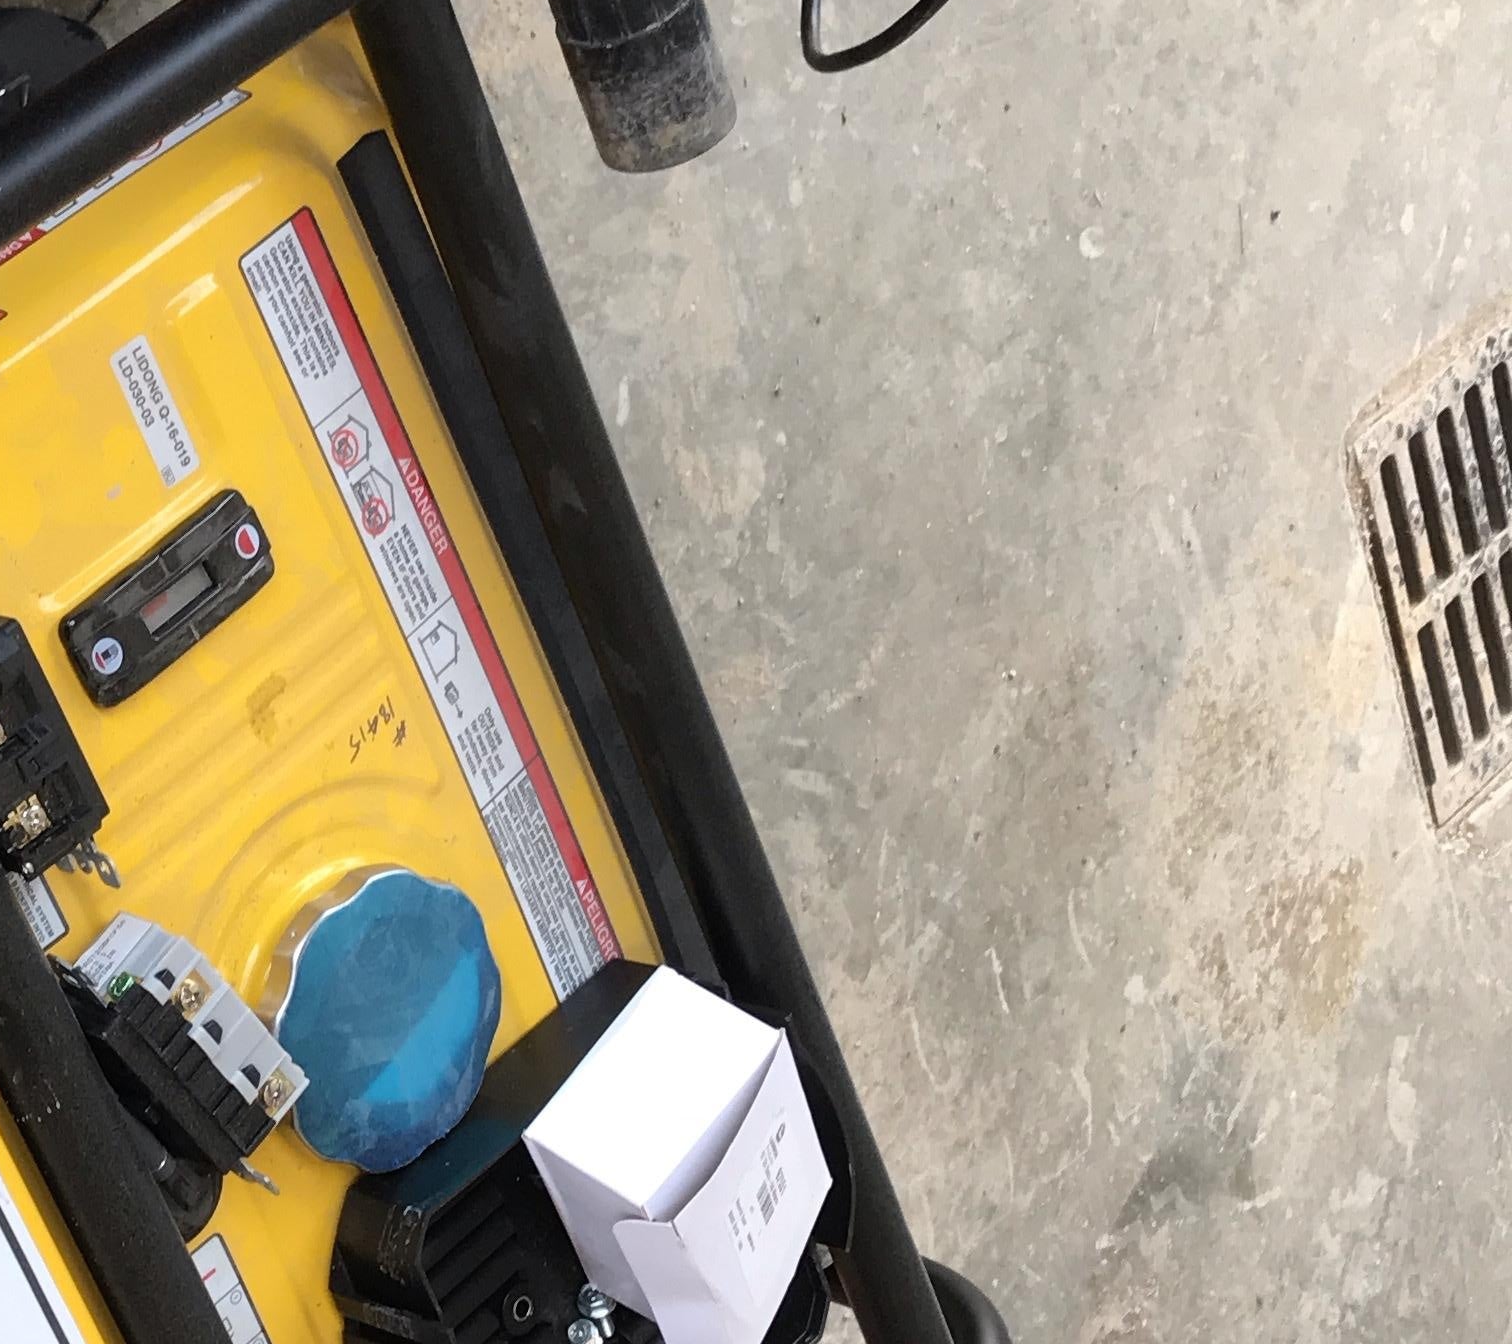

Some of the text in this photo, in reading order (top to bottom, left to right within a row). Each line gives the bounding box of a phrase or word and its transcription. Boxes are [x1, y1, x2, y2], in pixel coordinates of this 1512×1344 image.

[286, 263, 301, 289] KILL
[297, 287, 311, 312] YOU
[116, 355, 157, 428] LD-030-03
[130, 345, 193, 468] LIDONG Q-16-019
[396, 537, 411, 564] home
[404, 467, 449, 556] DANGER
[386, 536, 401, 564] EVEN
[402, 573, 417, 601] doors
[414, 601, 426, 620] and
[400, 523, 438, 604] NEVER use inside
